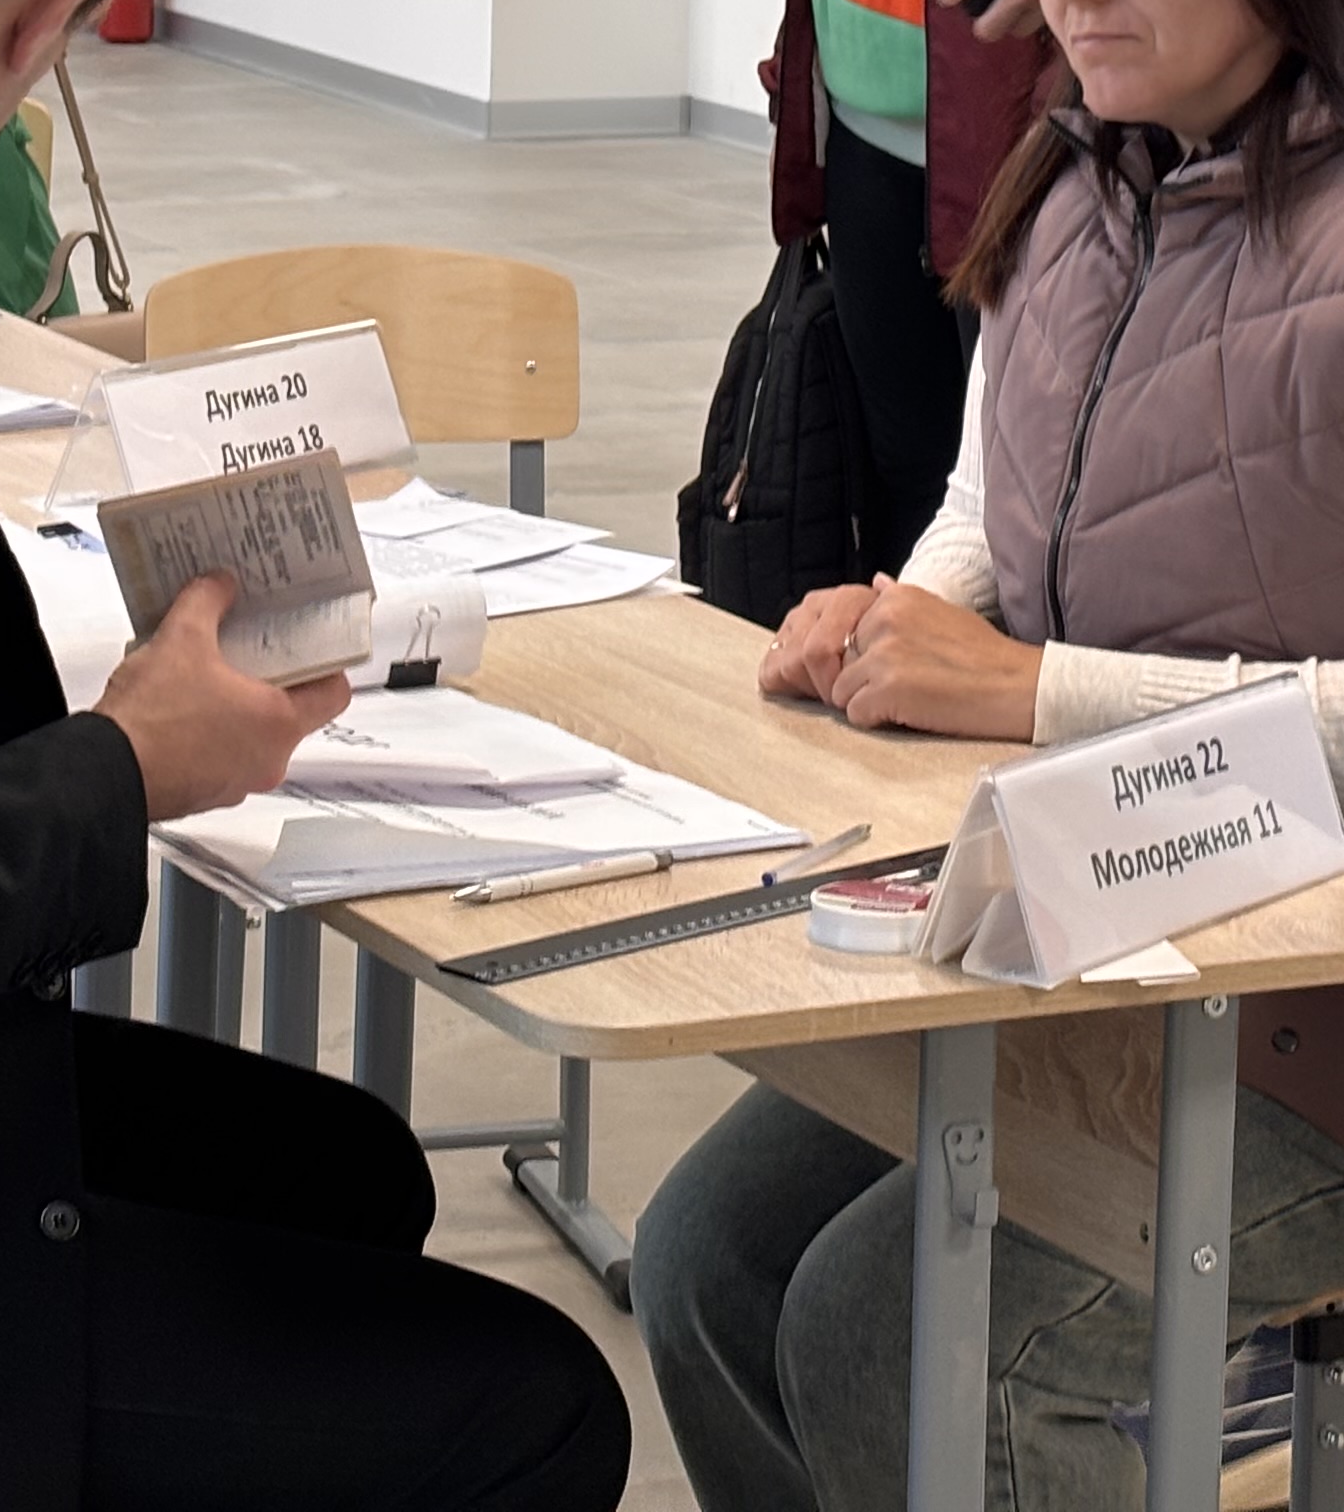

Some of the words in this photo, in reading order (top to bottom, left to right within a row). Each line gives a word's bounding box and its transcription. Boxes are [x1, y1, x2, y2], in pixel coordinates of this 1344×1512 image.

[205, 383, 280, 423] Дугина
[281, 372, 308, 400] 20
[220, 437, 295, 475] Дугина
[298, 424, 324, 452] 18
[1111, 754, 1197, 812] Дугина
[1197, 736, 1229, 776] 22
[1090, 818, 1252, 890] Молодежная
[1253, 800, 1283, 839] 11
